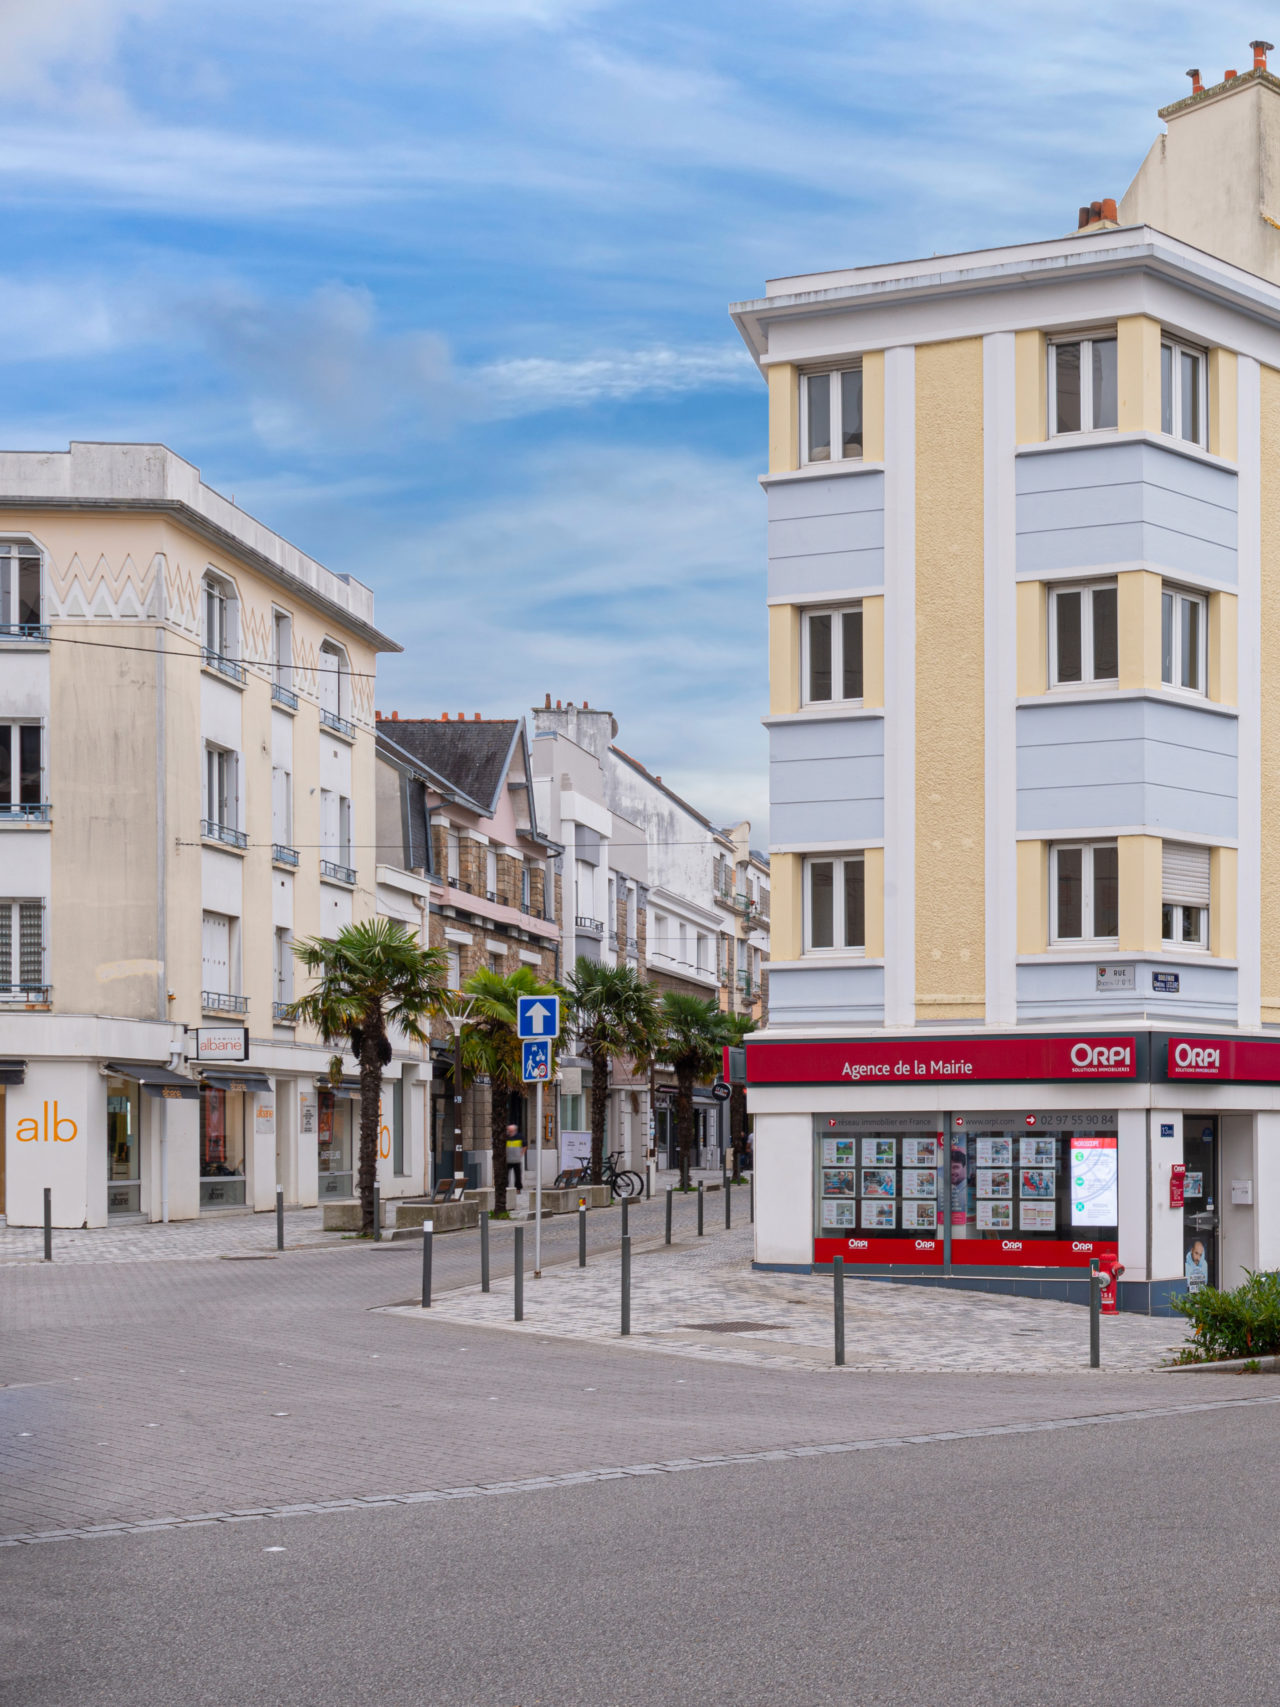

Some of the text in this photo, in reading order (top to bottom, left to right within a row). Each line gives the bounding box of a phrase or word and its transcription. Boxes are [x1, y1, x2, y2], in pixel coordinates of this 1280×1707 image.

[1113, 969, 1126, 977] RUE
[200, 1037, 242, 1051] albane
[1070, 1042, 1131, 1067] ORPI
[1174, 1043, 1220, 1067] ORPI
[841, 1059, 973, 1080] Agence de la Mairie
[16, 1099, 78, 1142] alb
[1041, 1114, 1114, 1125] 02 97 55 90 84
[848, 1239, 868, 1248] ORPI
[915, 1240, 935, 1248] ORPI
[1002, 1240, 1022, 1249] ORPI
[1072, 1241, 1093, 1250] ORPI
